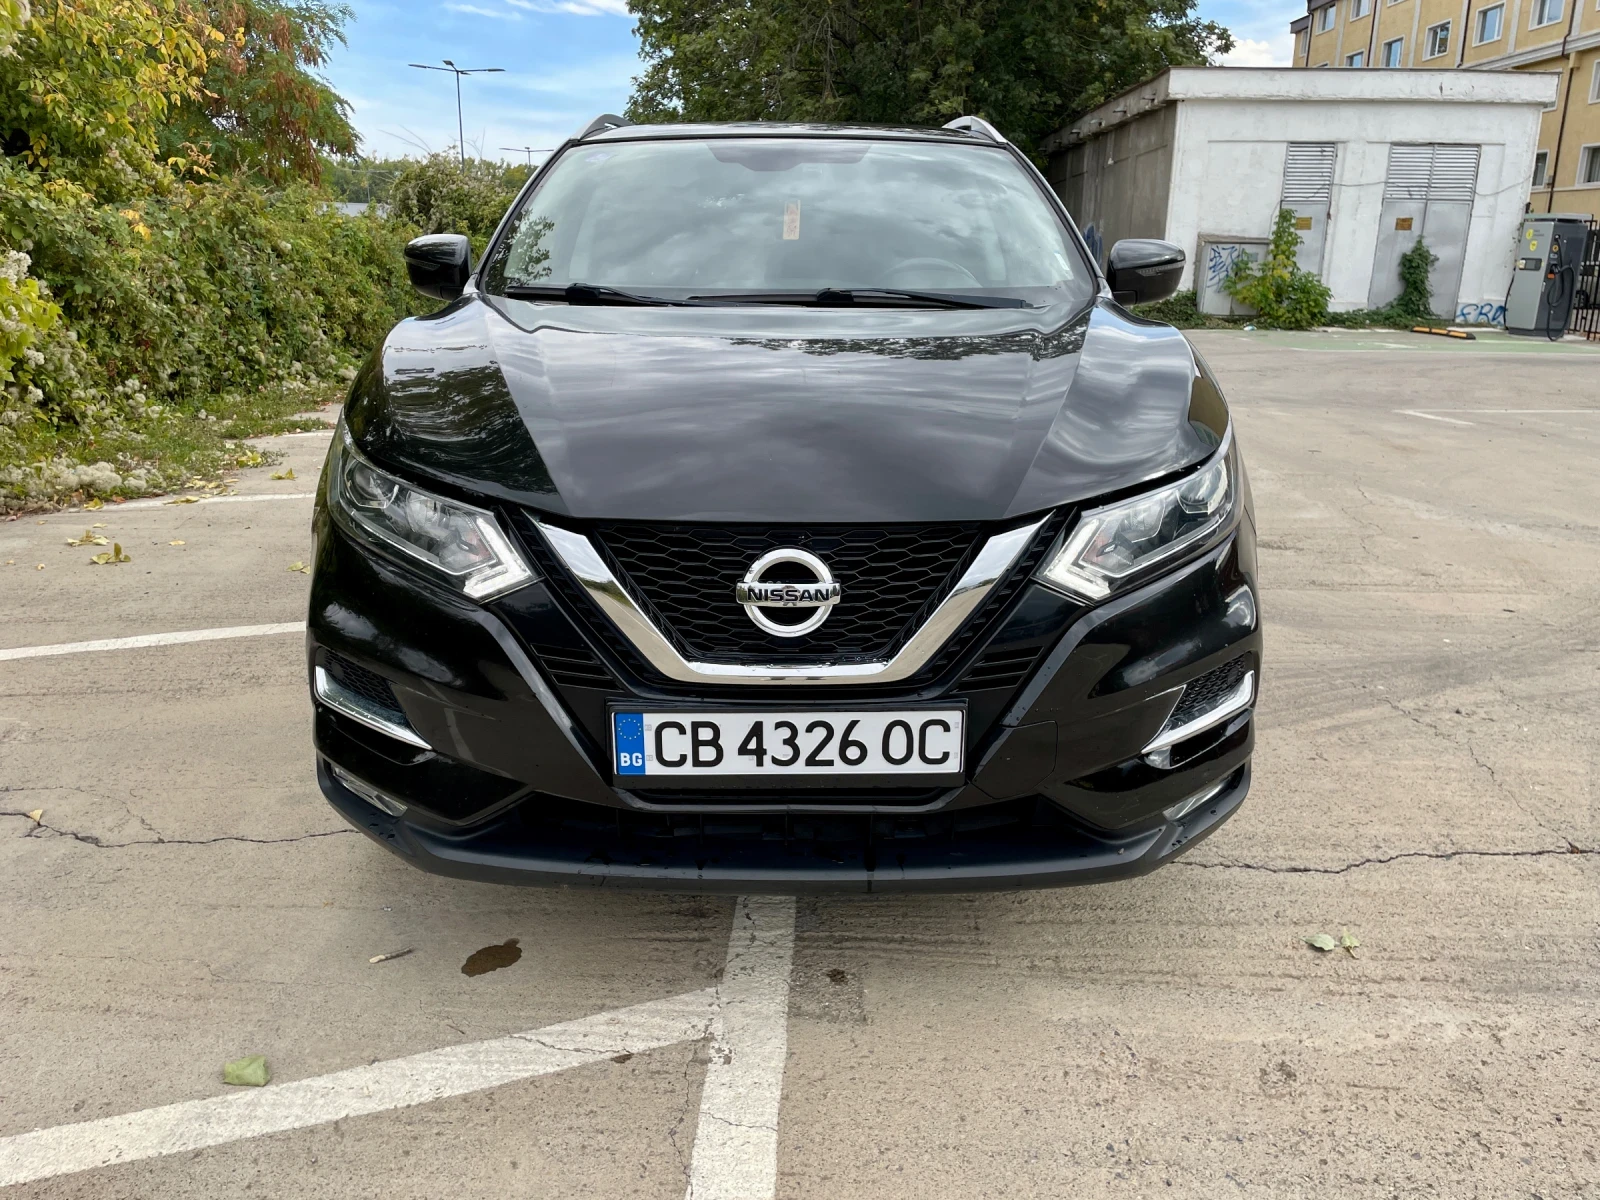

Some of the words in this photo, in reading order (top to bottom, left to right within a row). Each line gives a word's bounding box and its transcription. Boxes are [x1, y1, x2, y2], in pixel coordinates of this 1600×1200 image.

[747, 588, 830, 602] NISSAN
[654, 720, 724, 768] CB
[737, 720, 868, 767] 4326
[881, 719, 951, 766] OC
[620, 752, 643, 767] BG
